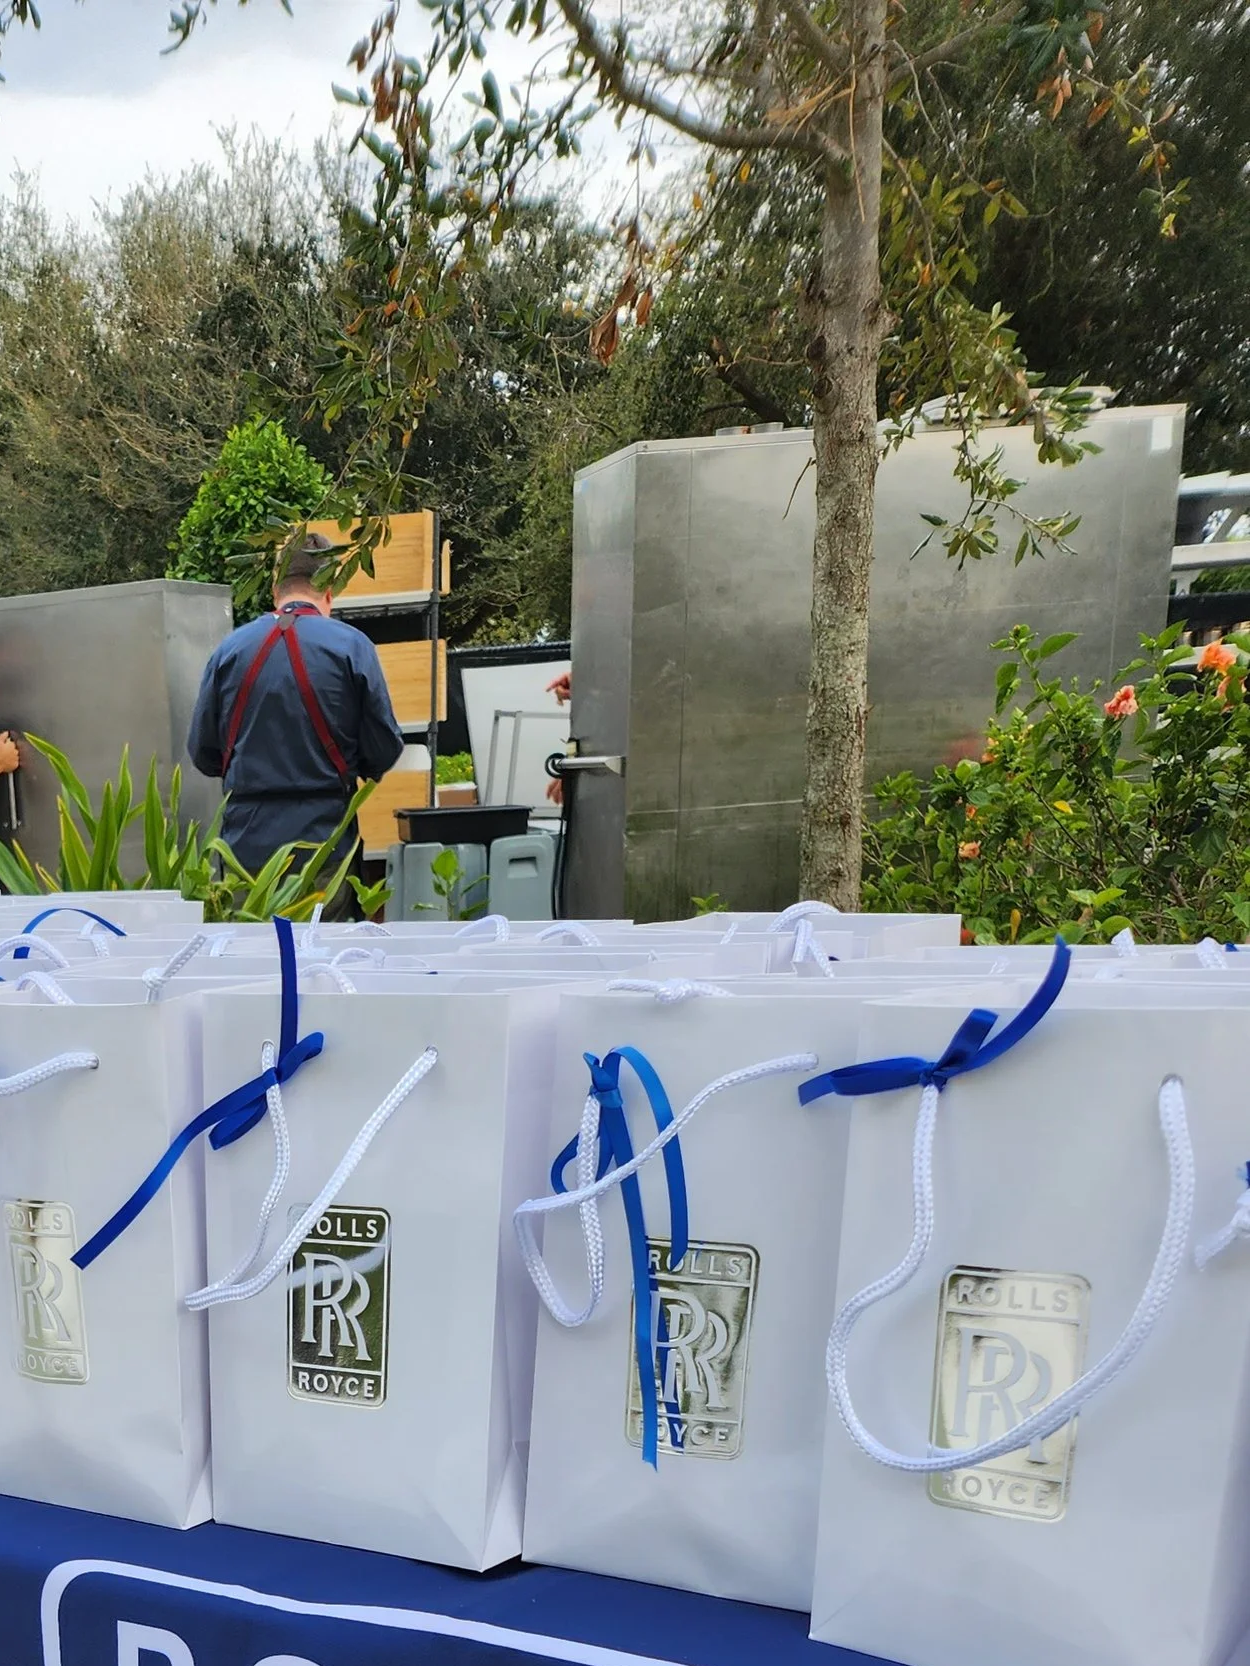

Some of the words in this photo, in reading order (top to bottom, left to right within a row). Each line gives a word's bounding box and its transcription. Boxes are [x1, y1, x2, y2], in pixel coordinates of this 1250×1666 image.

[5, 1207, 64, 1231] ROLLS
[308, 1216, 378, 1239] OLLS
[957, 1279, 1069, 1313] ROLLS
[299, 1371, 375, 1398] ROYCE
[941, 1473, 1049, 1509] ROYCE
